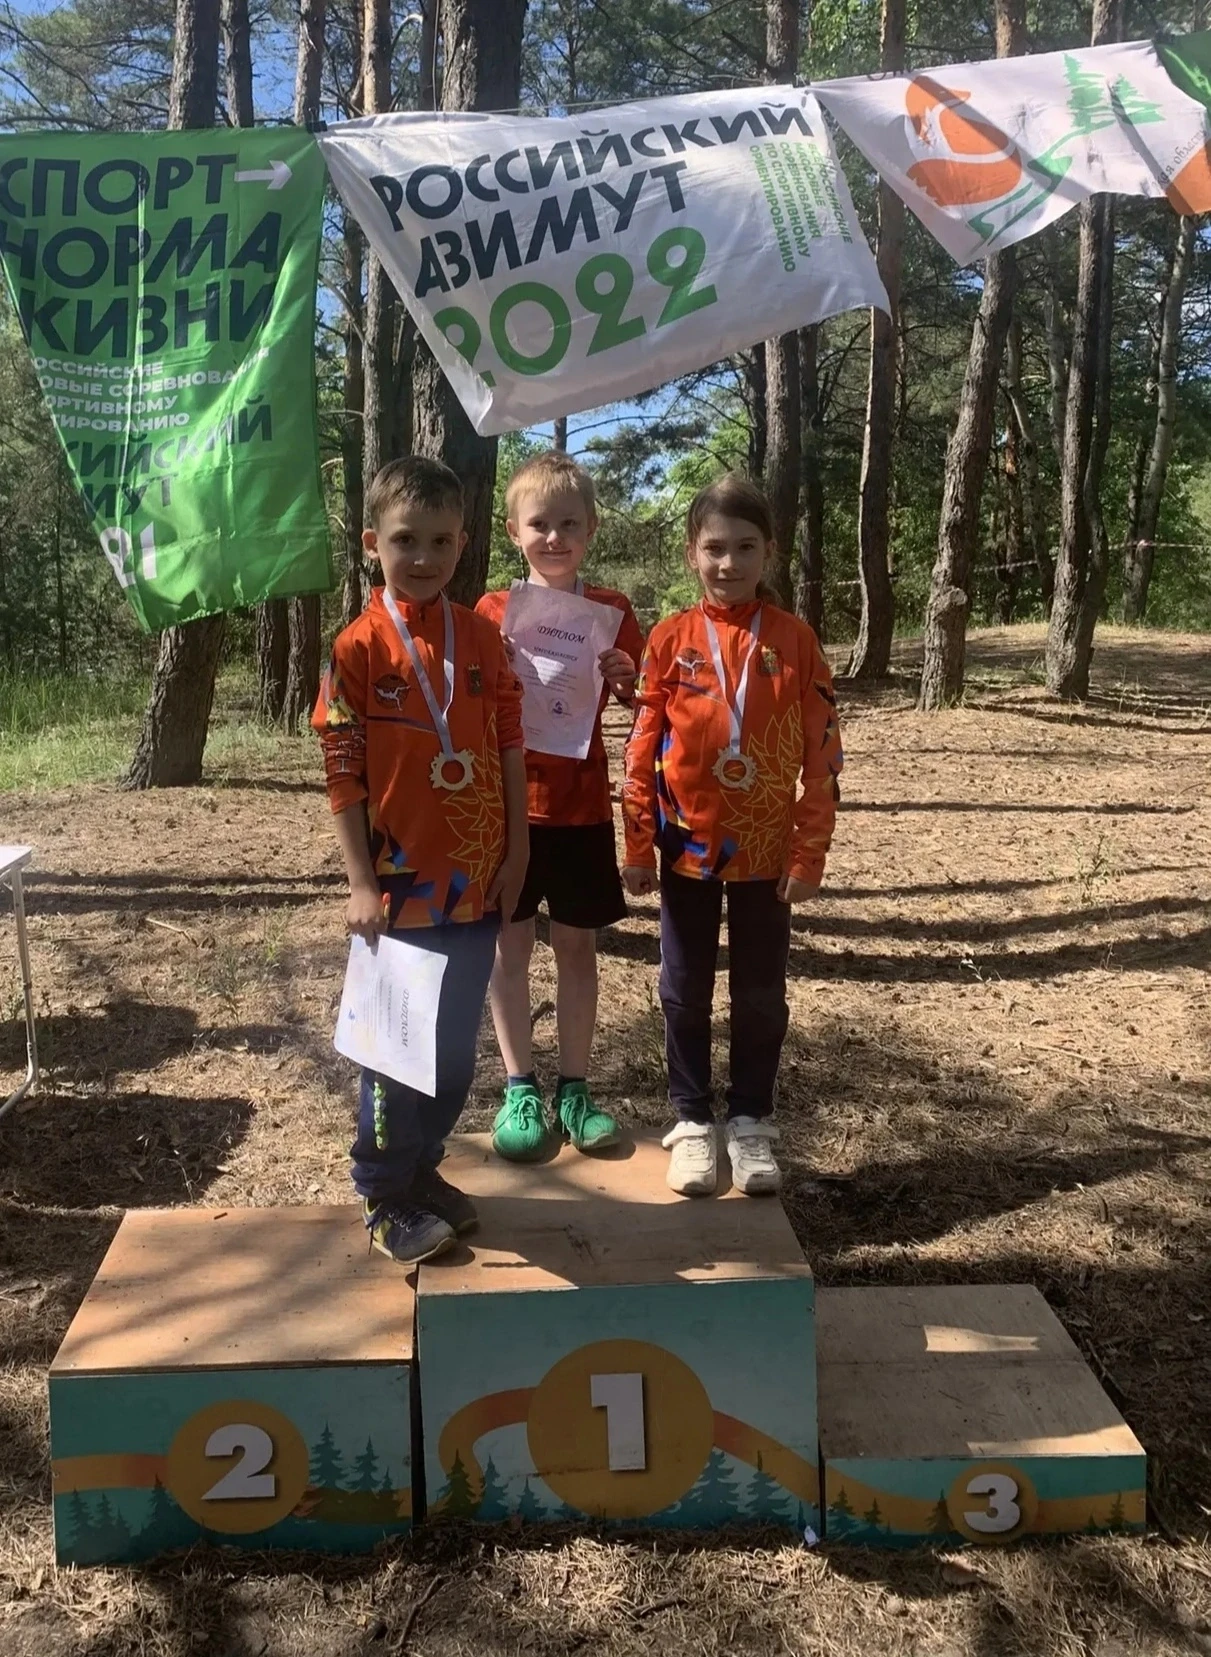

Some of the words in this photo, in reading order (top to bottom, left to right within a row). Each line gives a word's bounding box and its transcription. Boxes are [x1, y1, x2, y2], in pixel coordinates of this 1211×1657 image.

[0, 154, 237, 218] СПОРТ
[370, 102, 814, 231] РОССИЙСКИЙ
[764, 143, 779, 159] ПО
[773, 161, 811, 258] СПОРТИВНОМУ
[780, 142, 822, 239] СОРЕВНОВАНИЯ
[794, 142, 825, 207] МАССОВЫЕ
[415, 161, 688, 298] АЗИМУТ
[750, 145, 797, 273] ОРИЕНТИРОВАНИЮ
[0, 211, 282, 289] НОРМА
[433, 226, 718, 387] 2022
[32, 356, 164, 380] ОССИЙСКИЕ
[40, 375, 103, 396] ОВЫЕ
[45, 394, 178, 415] ОРТИВНОМУ
[101, 521, 157, 588] 21
[537, 625, 586, 644] ДИПЛОМ
[589, 1372, 646, 1471] 1
[200, 1423, 276, 1500] 2
[963, 1472, 1021, 1533] 3
